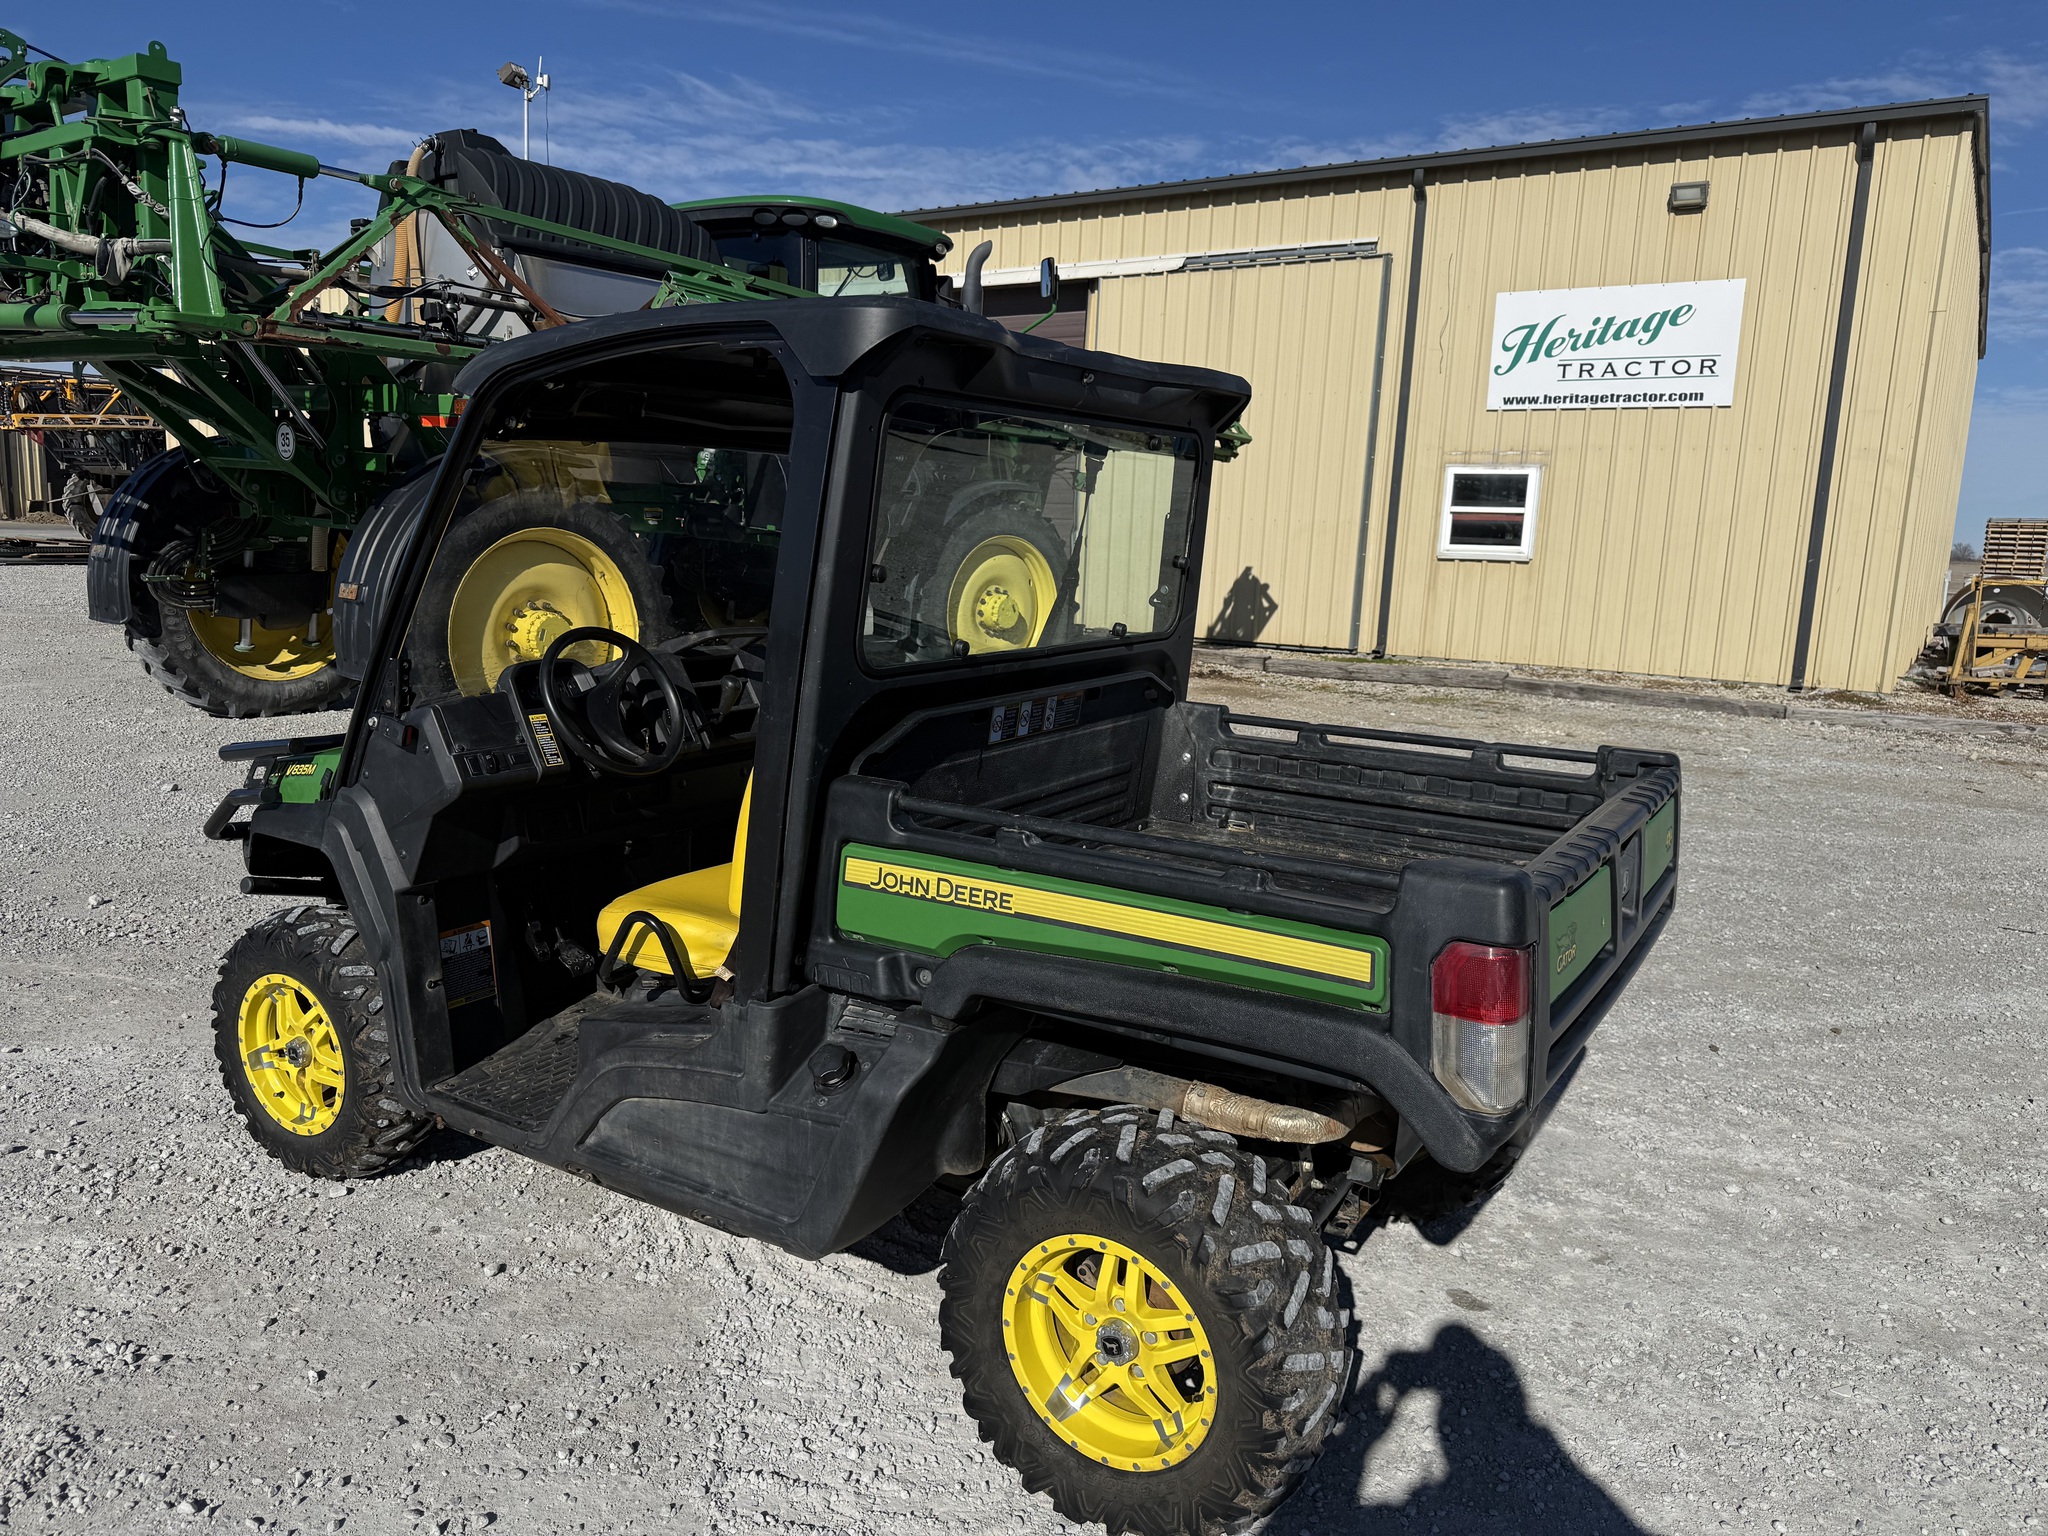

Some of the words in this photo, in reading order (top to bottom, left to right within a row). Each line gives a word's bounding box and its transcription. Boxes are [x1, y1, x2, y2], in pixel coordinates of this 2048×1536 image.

[1494, 304, 1697, 376] Heritage
[1557, 358, 1717, 379] TRACTOR
[1503, 391, 1704, 405] www.heritagetractor.com
[281, 432, 290, 447] 35
[870, 867, 930, 896] JOHN
[936, 877, 1013, 910] DEERE
[1556, 943, 1577, 973] GATOR
